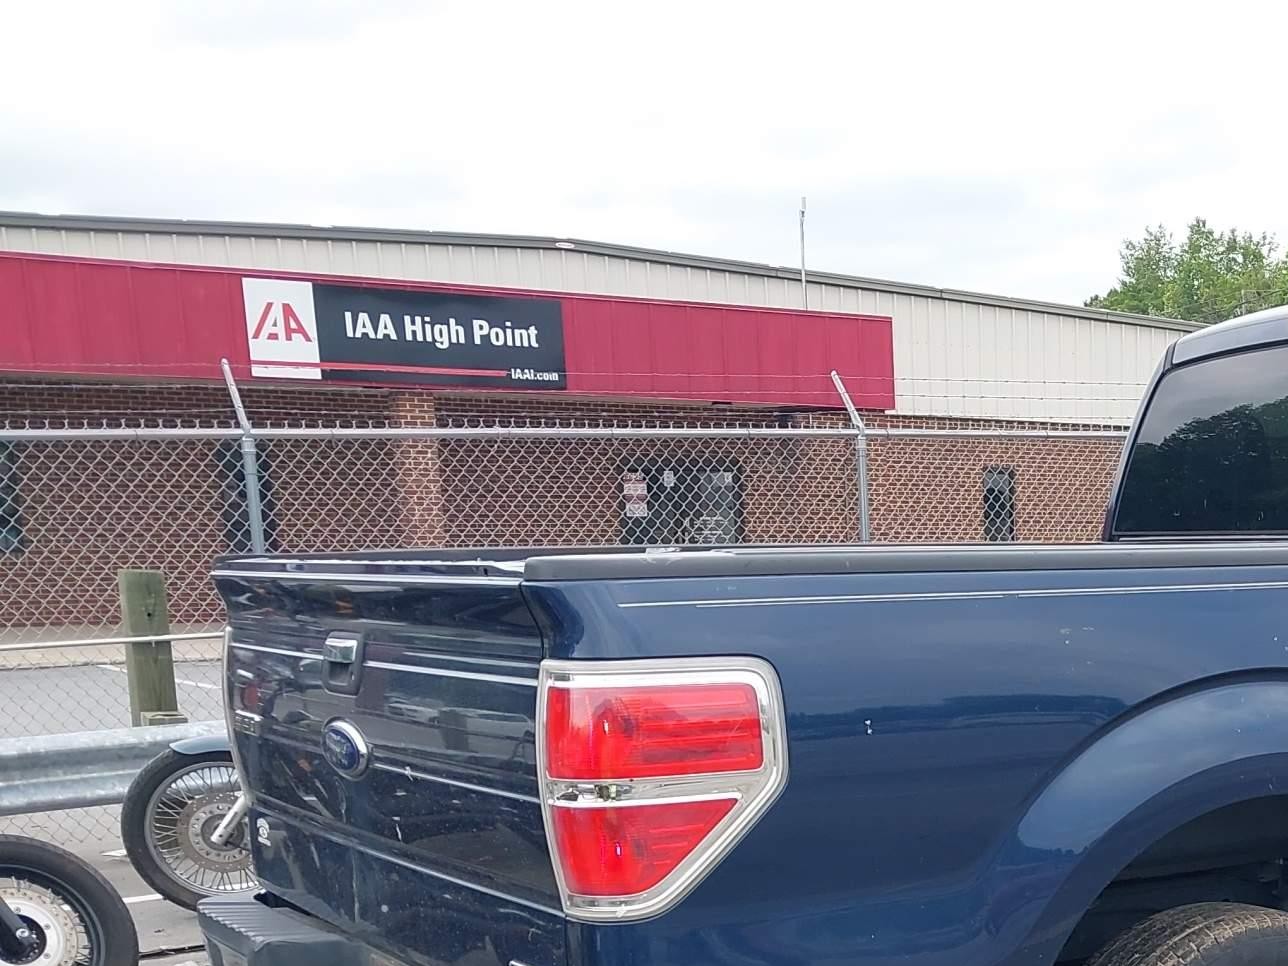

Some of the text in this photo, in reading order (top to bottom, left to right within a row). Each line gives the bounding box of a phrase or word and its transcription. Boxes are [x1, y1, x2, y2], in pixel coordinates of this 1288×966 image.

[344, 311, 539, 350] IAA High Point
[511, 368, 559, 381] IAAI.com
